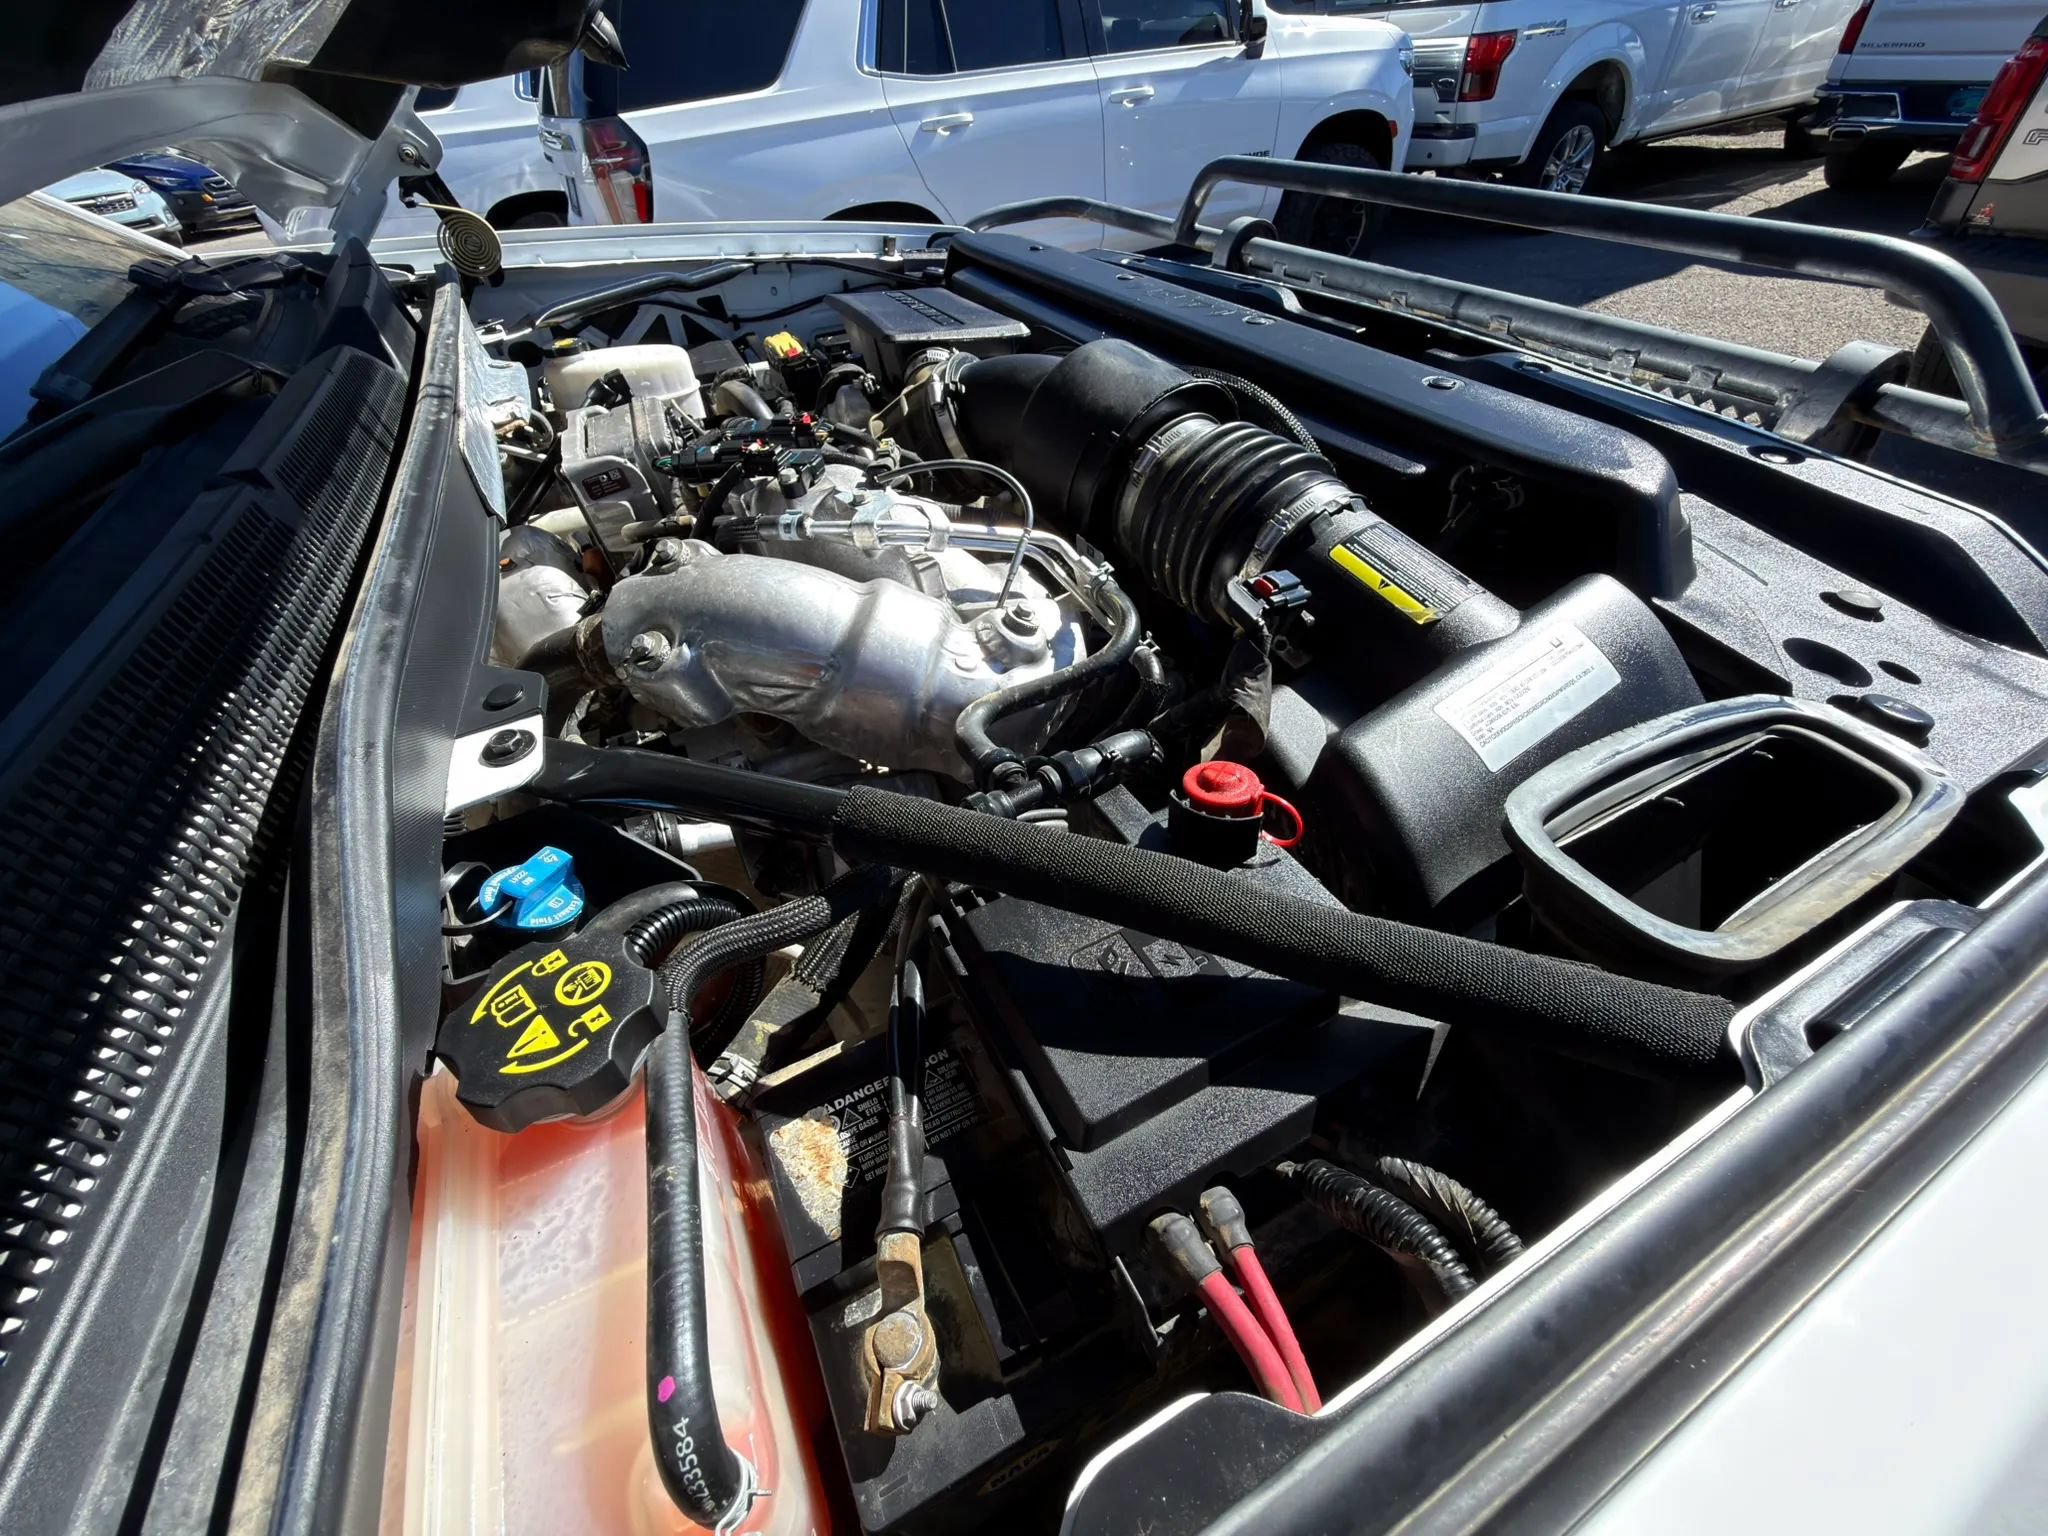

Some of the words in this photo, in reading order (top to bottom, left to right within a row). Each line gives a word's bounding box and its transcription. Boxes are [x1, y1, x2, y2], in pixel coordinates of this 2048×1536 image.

[857, 1097, 879, 1112] SHIELD
[837, 1125, 859, 1141] LOSIVE
[858, 1116, 879, 1131] GASES
[930, 1135, 940, 1144] DO
[940, 1128, 952, 1139] NOT
[858, 1151, 875, 1163] FLUSH
[874, 1144, 888, 1155] EYES
[875, 1152, 889, 1164] WATE
[864, 1171, 875, 1182] GET
